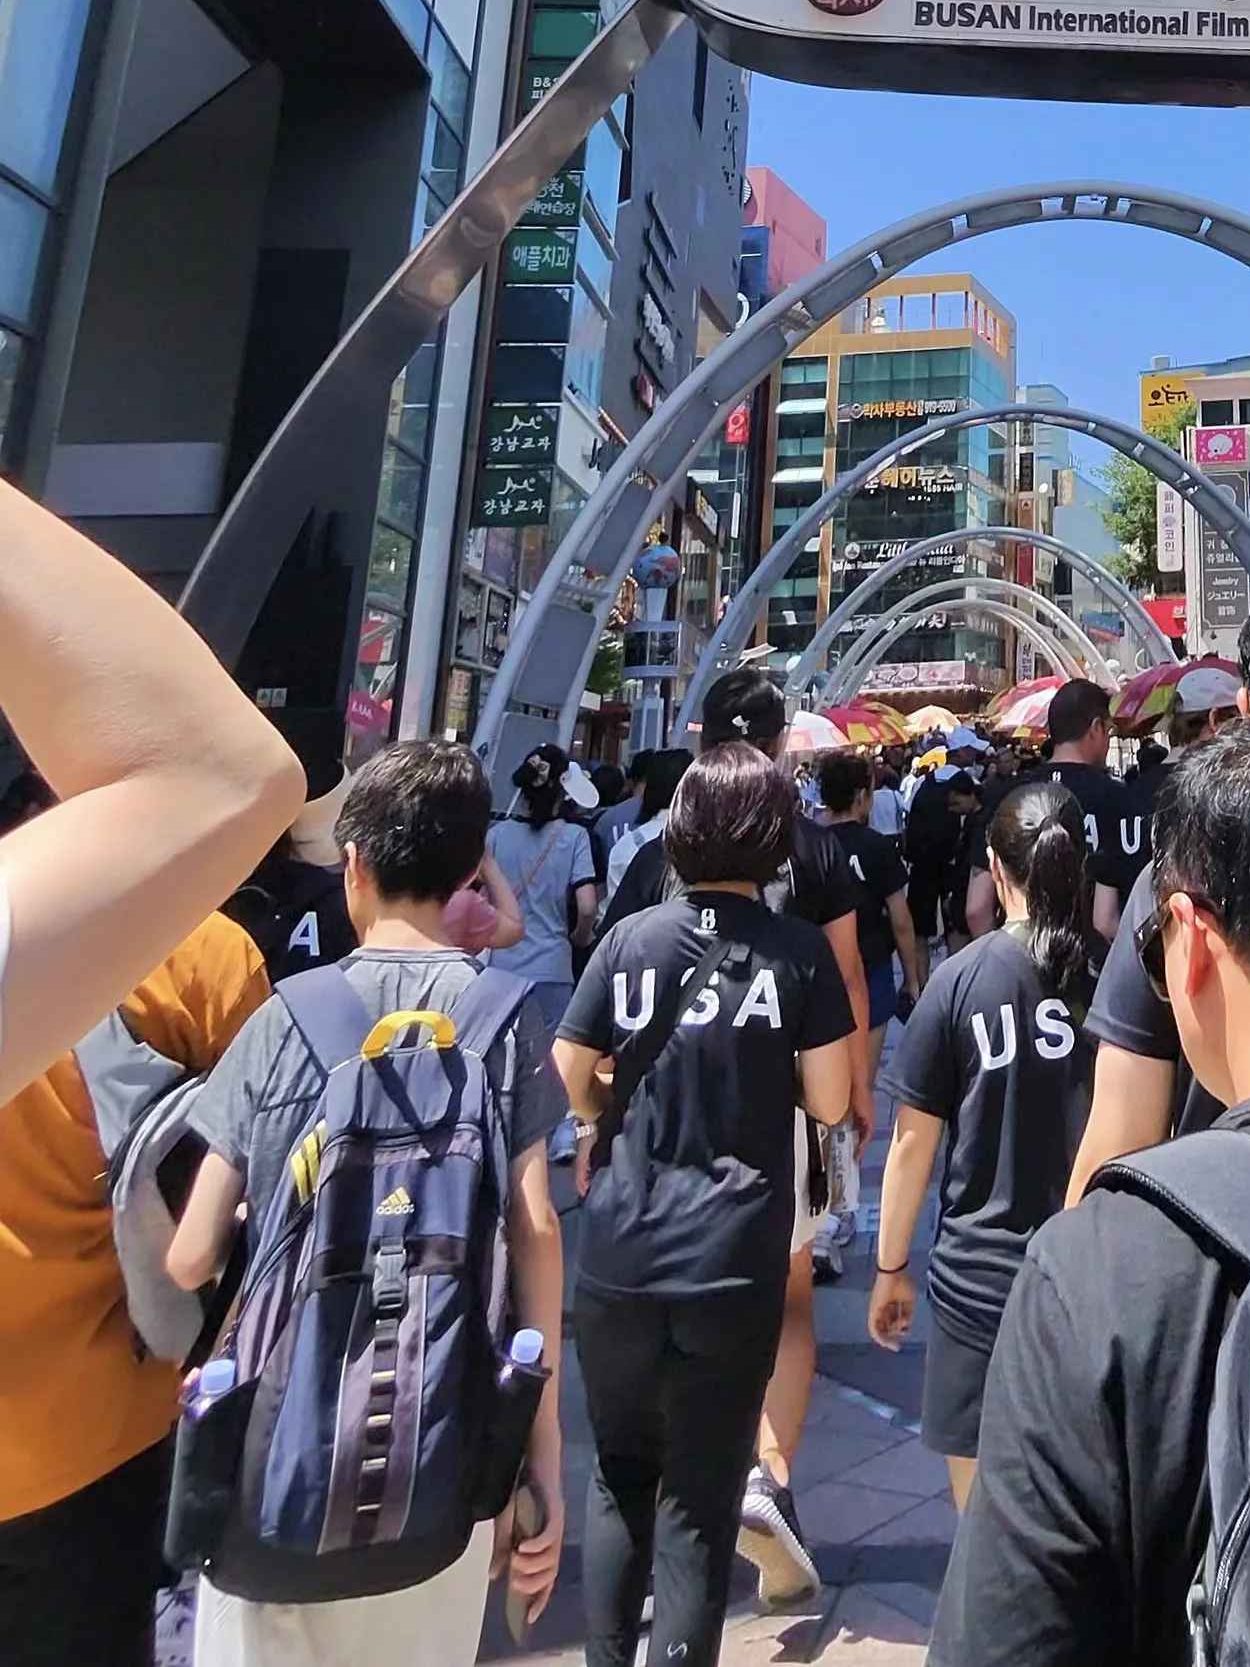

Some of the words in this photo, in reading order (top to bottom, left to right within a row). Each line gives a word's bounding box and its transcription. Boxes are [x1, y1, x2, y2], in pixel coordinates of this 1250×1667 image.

[914, 1, 1021, 30] BUSAN
[1028, 6, 1190, 36] International
[1197, 11, 1250, 39] Film
[524, 201, 576, 216] 래연습장
[512, 245, 571, 271] 애플치과
[490, 436, 551, 452] 강남교자
[483, 498, 546, 515] 강남교자
[613, 967, 783, 1032] USA
[376, 1204, 415, 1214] adidas
